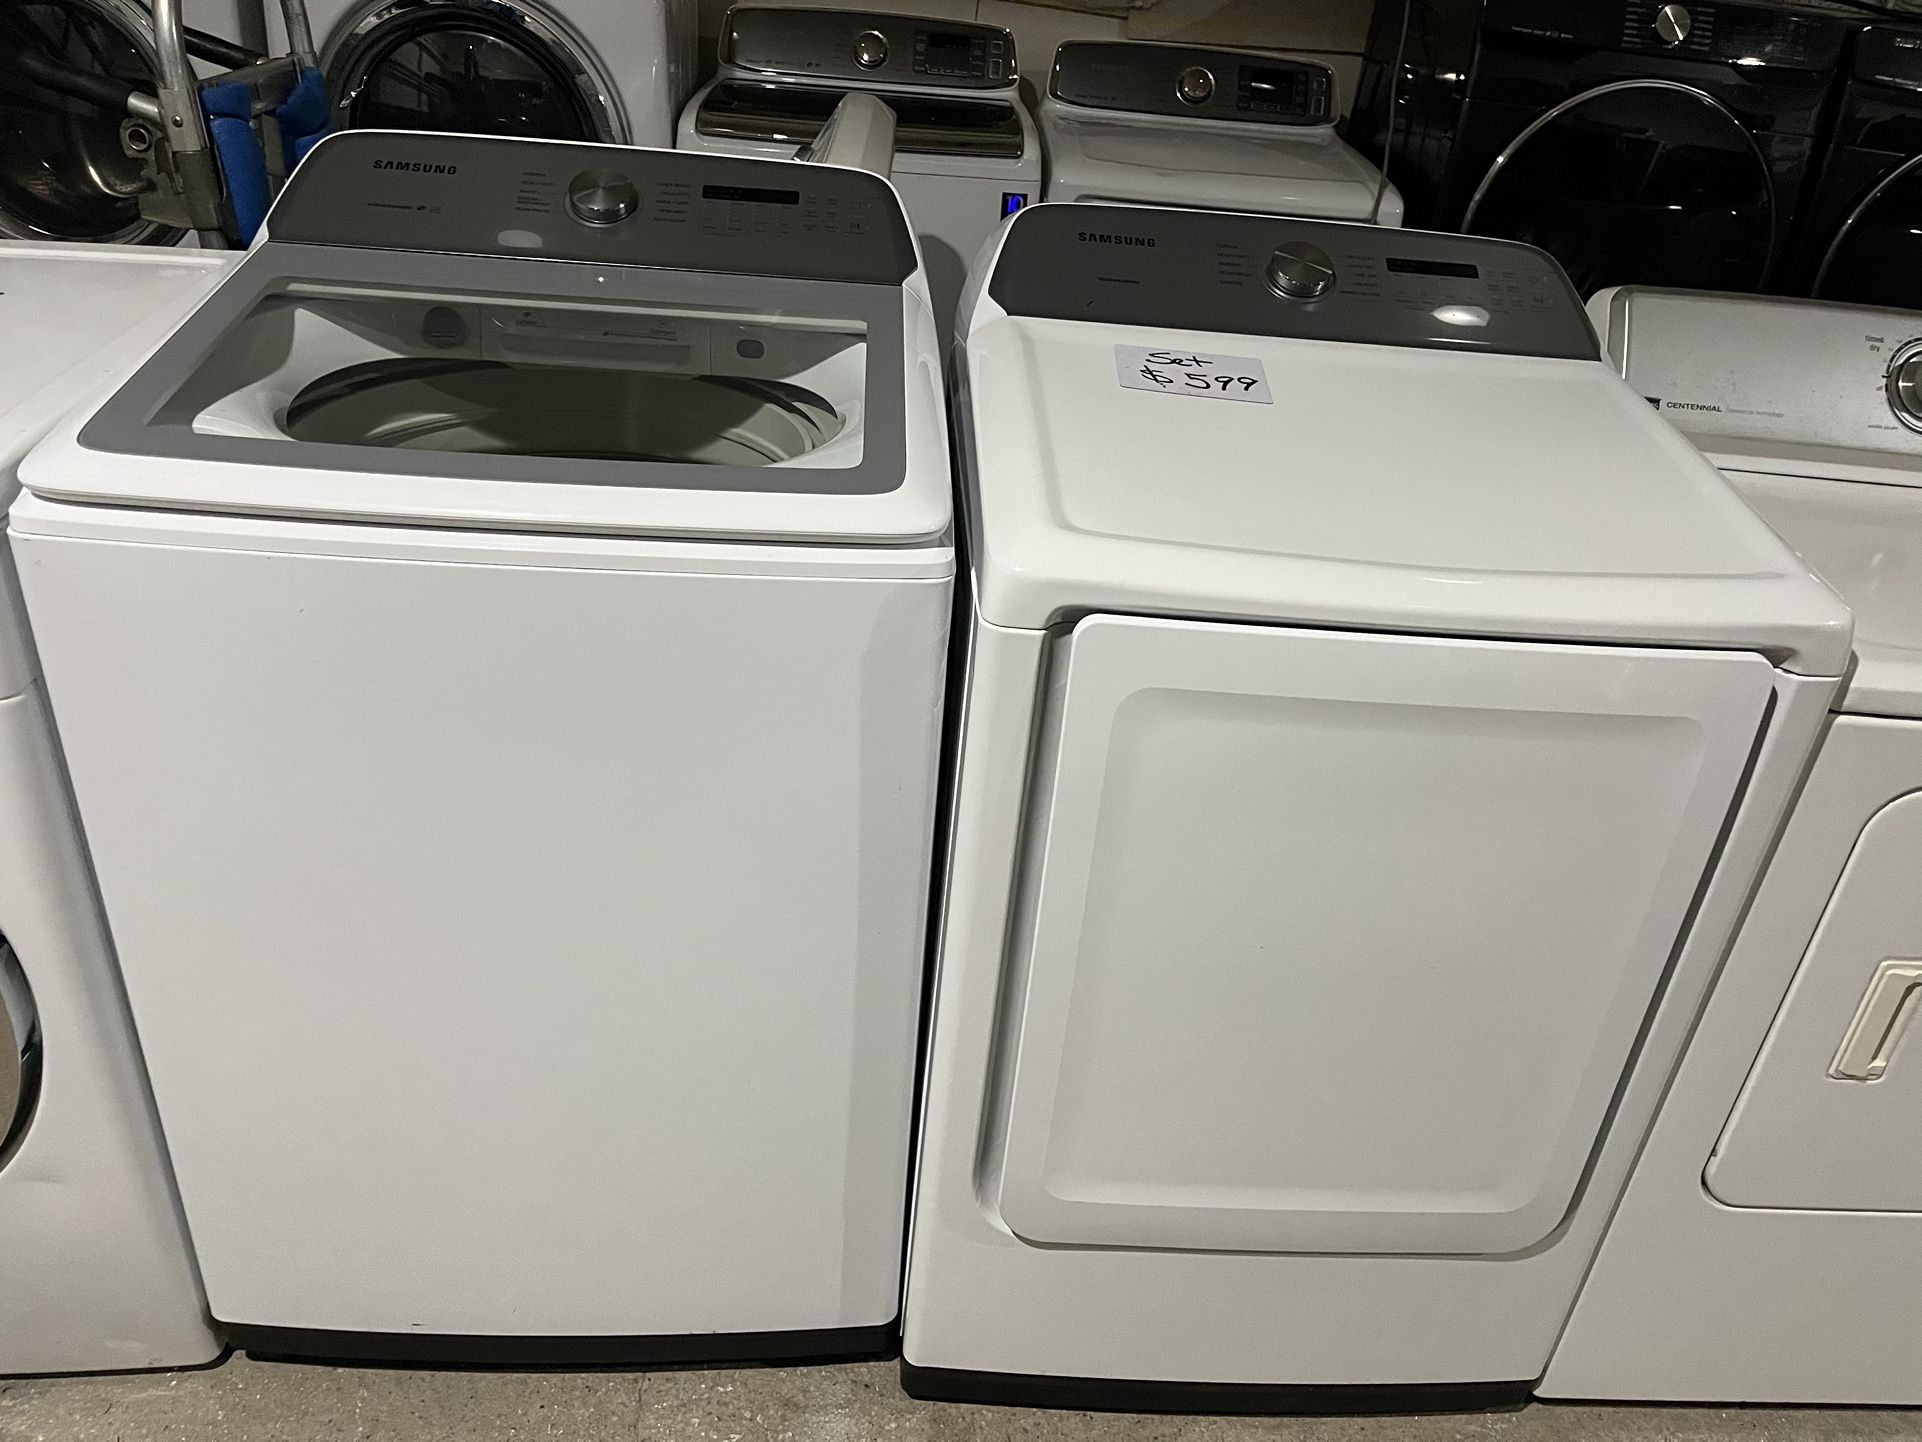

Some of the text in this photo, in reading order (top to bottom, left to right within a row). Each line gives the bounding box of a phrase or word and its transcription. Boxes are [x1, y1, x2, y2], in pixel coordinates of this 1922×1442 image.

[373, 159, 457, 175] SAMSUNG
[1078, 232, 1156, 247] SAMSUNG
[1145, 352, 1213, 367] Set
[1666, 401, 1723, 412] CENTENNIAL
